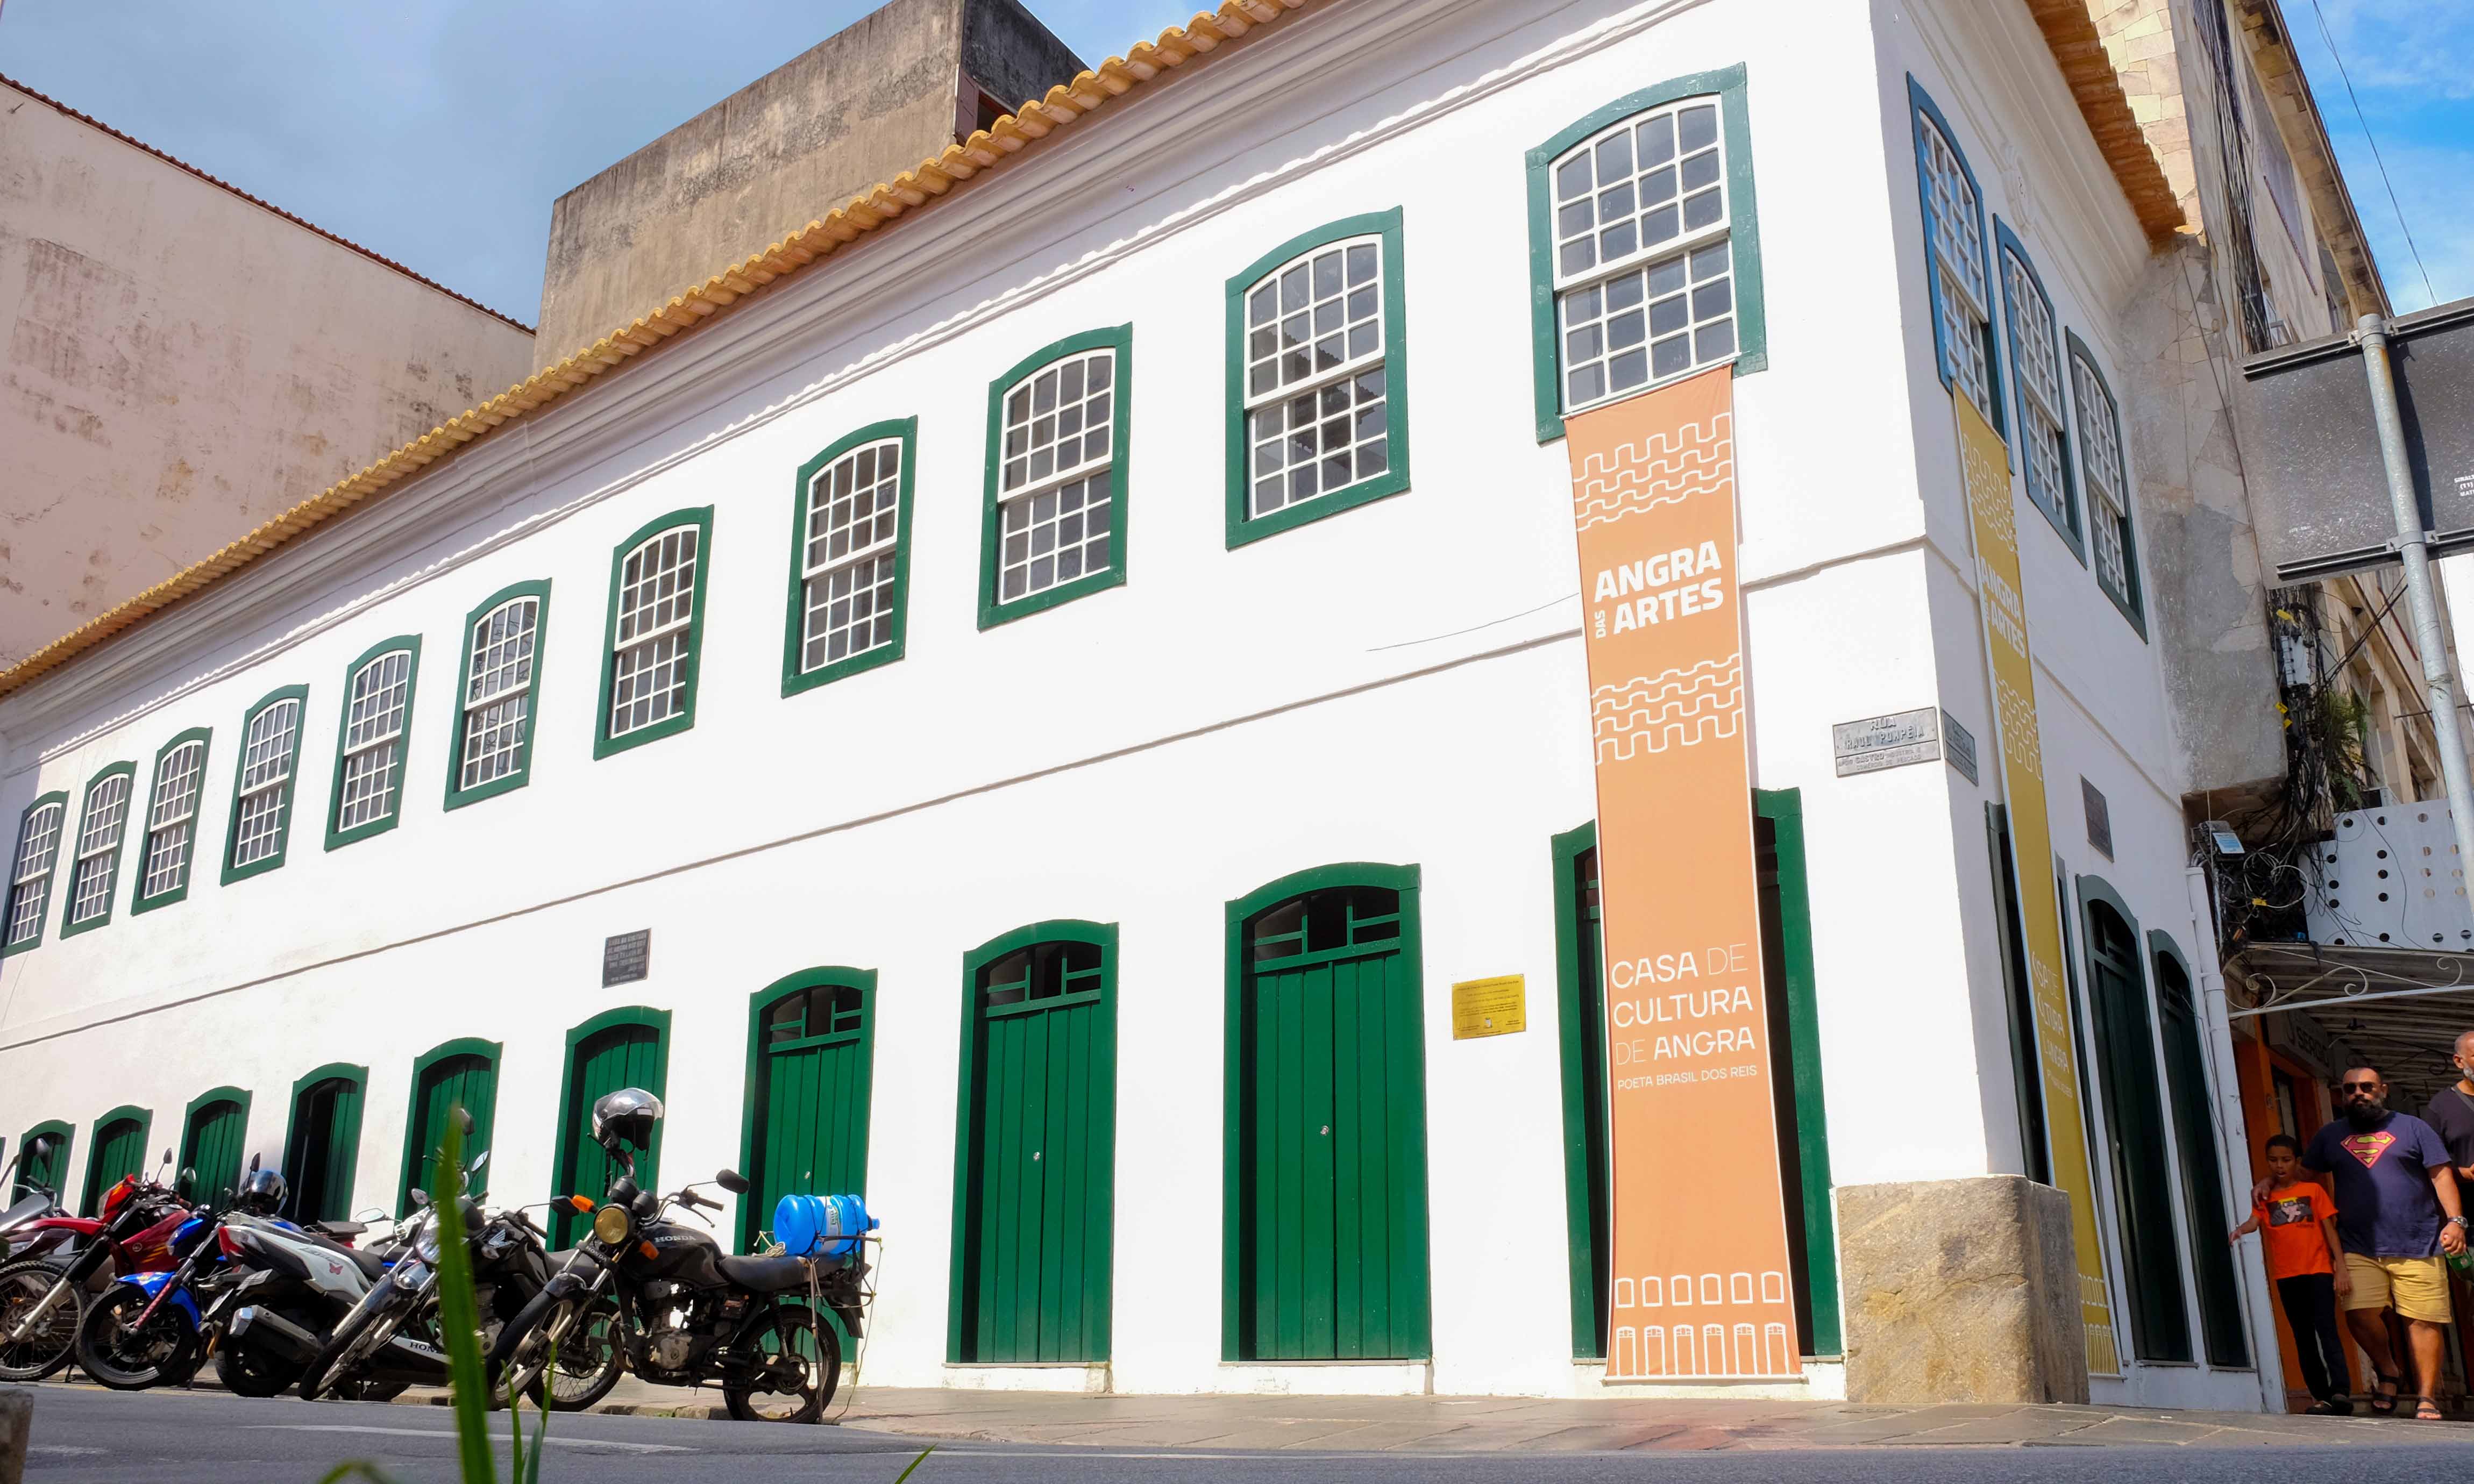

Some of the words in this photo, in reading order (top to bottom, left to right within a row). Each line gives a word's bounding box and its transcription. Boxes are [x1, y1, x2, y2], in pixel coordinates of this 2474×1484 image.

[1594, 540, 1722, 603] ANGRA
[1980, 555, 2022, 625] ANGRA
[1594, 609, 1606, 639] DAS
[1613, 578, 1724, 635] ARTES
[1990, 601, 2026, 659] ARTES
[1845, 735, 1872, 750] RAUL
[1611, 951, 1699, 989] CASA
[1707, 943, 1748, 976] DE
[1613, 986, 1753, 1028] CULTURA
[1615, 1039, 1646, 1066] DE
[1653, 1026, 1756, 1061] ANGRA
[1618, 1076, 1653, 1090] POETA
[1657, 1072, 1698, 1086] BRASIL
[1701, 1068, 1727, 1082] DOS
[1730, 1065, 1757, 1078] REIS
[586, 1245, 607, 1262] HONDA
[655, 1235, 696, 1243] HONDA
[409, 1342, 443, 1354] HON
